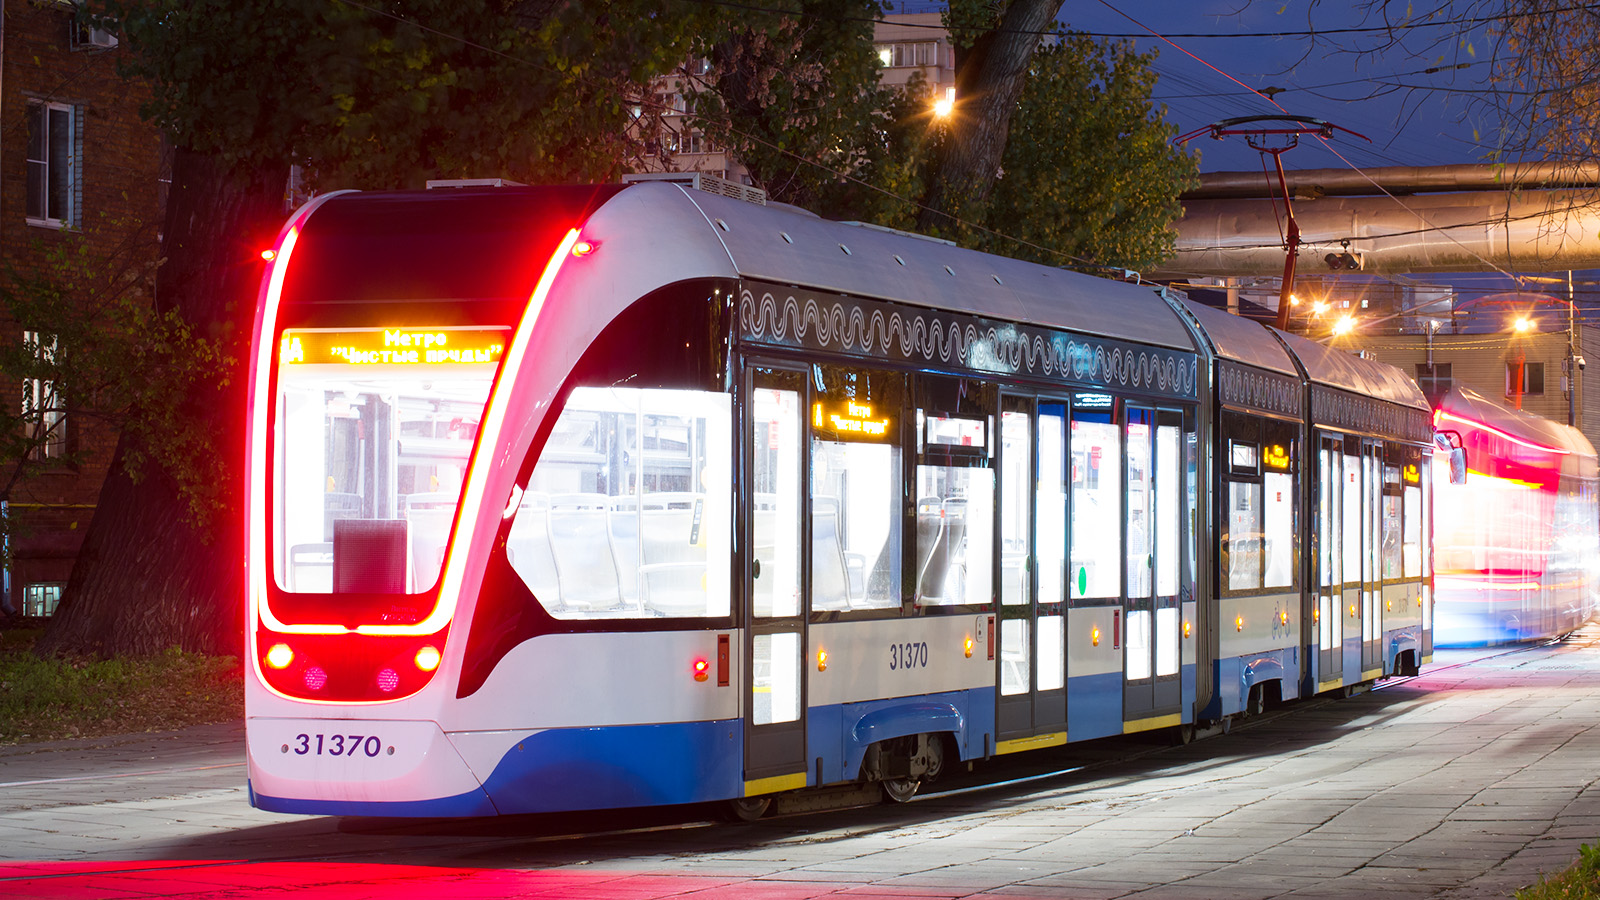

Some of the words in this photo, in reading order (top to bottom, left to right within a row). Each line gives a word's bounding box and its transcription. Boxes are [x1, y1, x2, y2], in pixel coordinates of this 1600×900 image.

[384, 329, 447, 348] Метро
[890, 641, 928, 670] 31370
[294, 733, 381, 757] 31370
